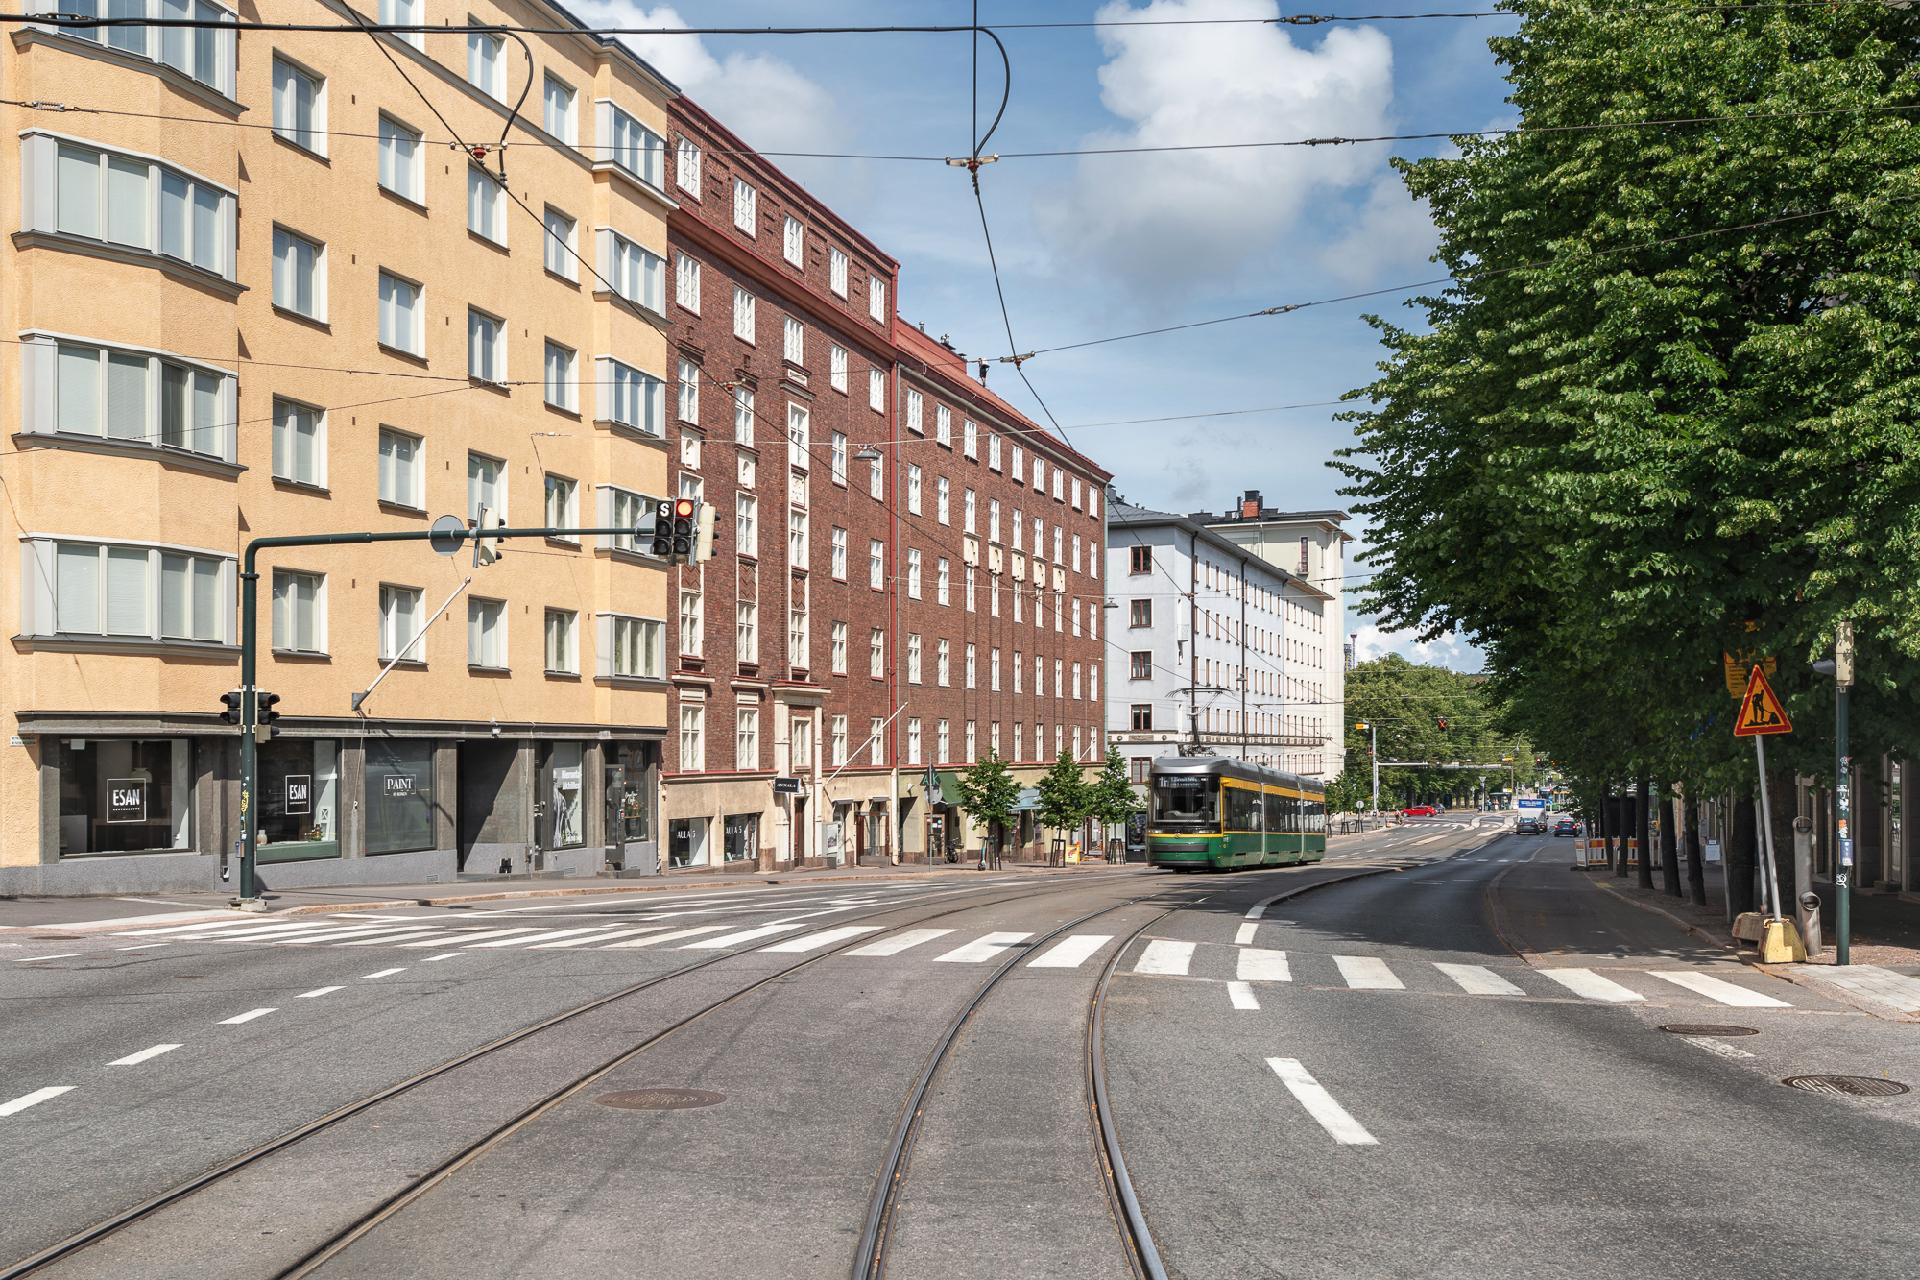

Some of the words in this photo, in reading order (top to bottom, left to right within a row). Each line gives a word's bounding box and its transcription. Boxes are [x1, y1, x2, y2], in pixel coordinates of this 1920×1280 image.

[660, 502, 670, 517] S
[387, 778, 413, 790] PAINT
[112, 788, 140, 806] ESAN
[289, 784, 307, 800] ESAN
